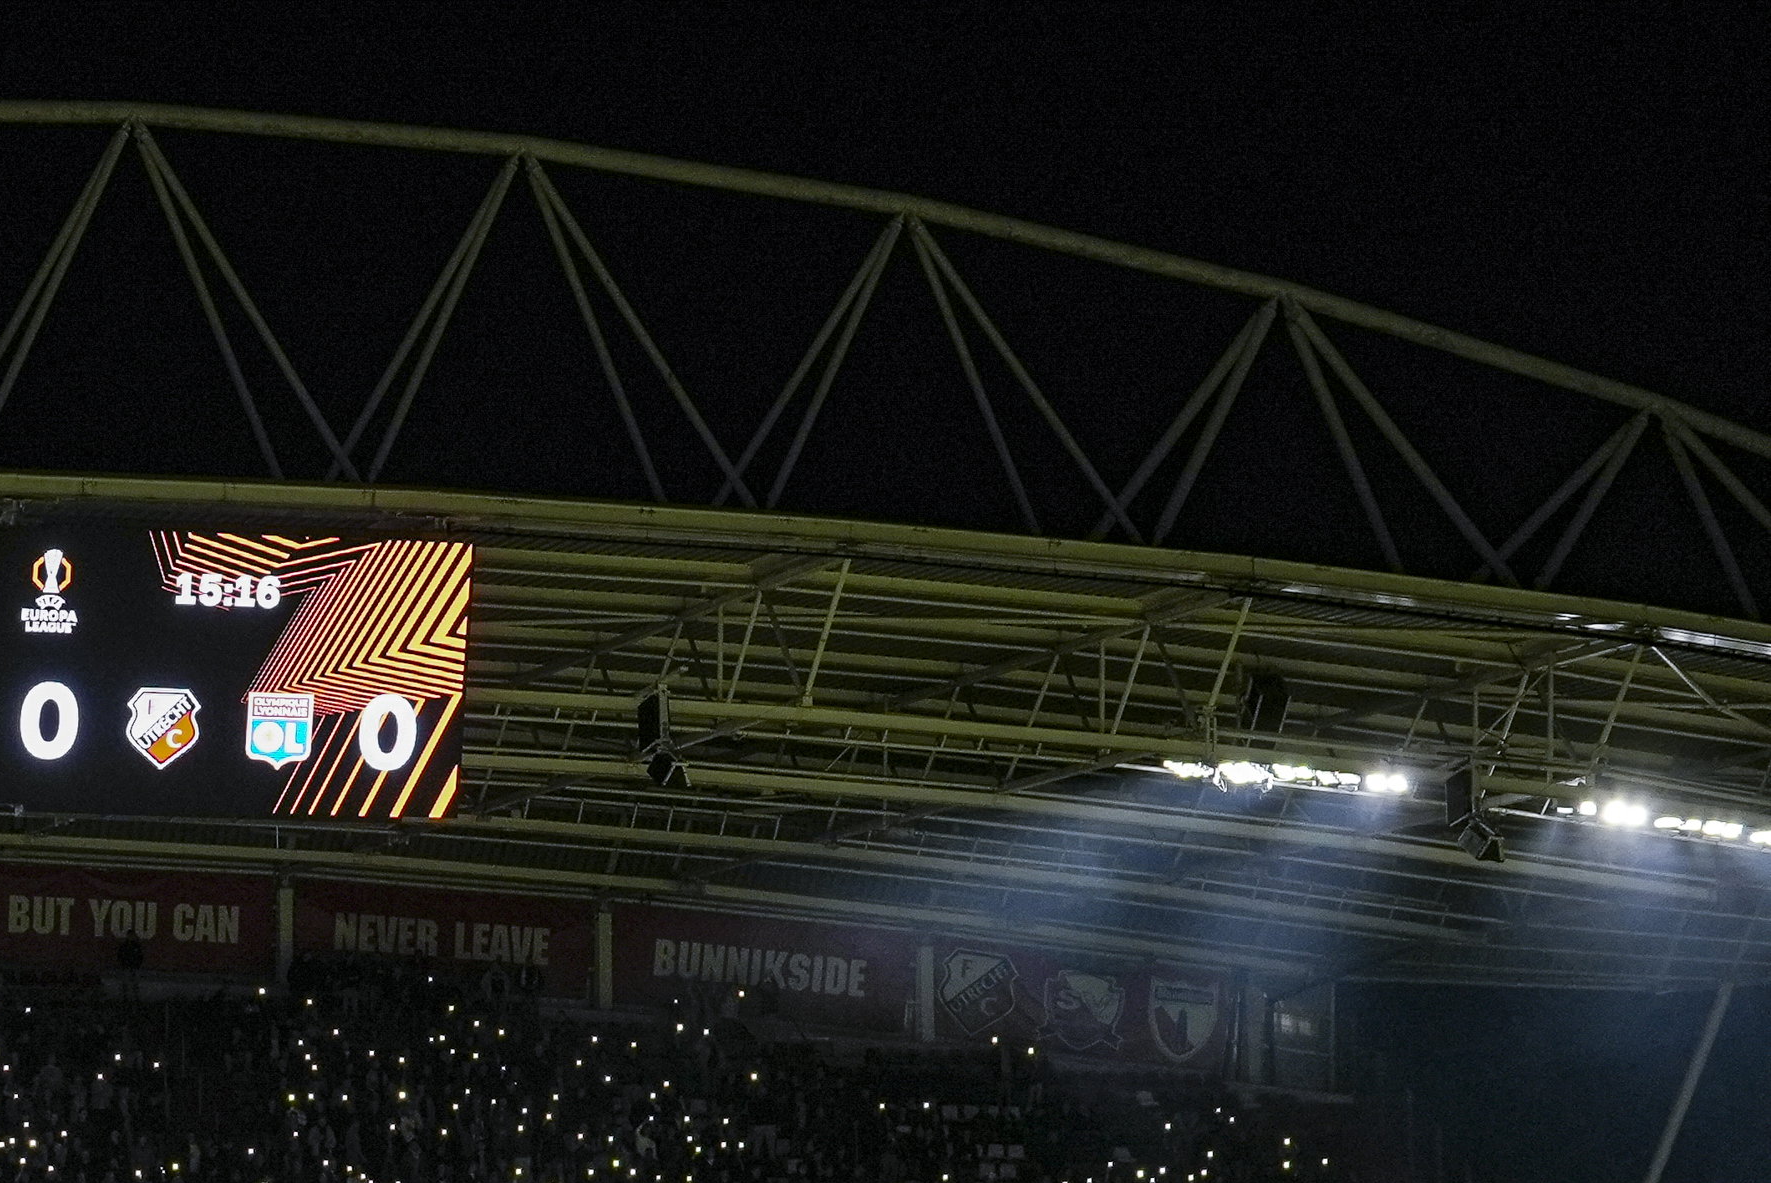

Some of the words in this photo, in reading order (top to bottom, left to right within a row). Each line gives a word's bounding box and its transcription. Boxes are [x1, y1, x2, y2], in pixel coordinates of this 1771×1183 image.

[21, 608, 78, 622] EUROPA
[175, 574, 281, 609] 15:16
[25, 620, 76, 633] LEAGUE
[20, 681, 78, 760] 0
[359, 694, 417, 771] 0
[8, 895, 79, 935] BUT
[91, 899, 158, 940] YOU
[173, 904, 240, 943] CAN
[335, 912, 438, 957] NEVER
[455, 921, 550, 965] LEAVE
[653, 938, 866, 998] BUNNIKSIDE
